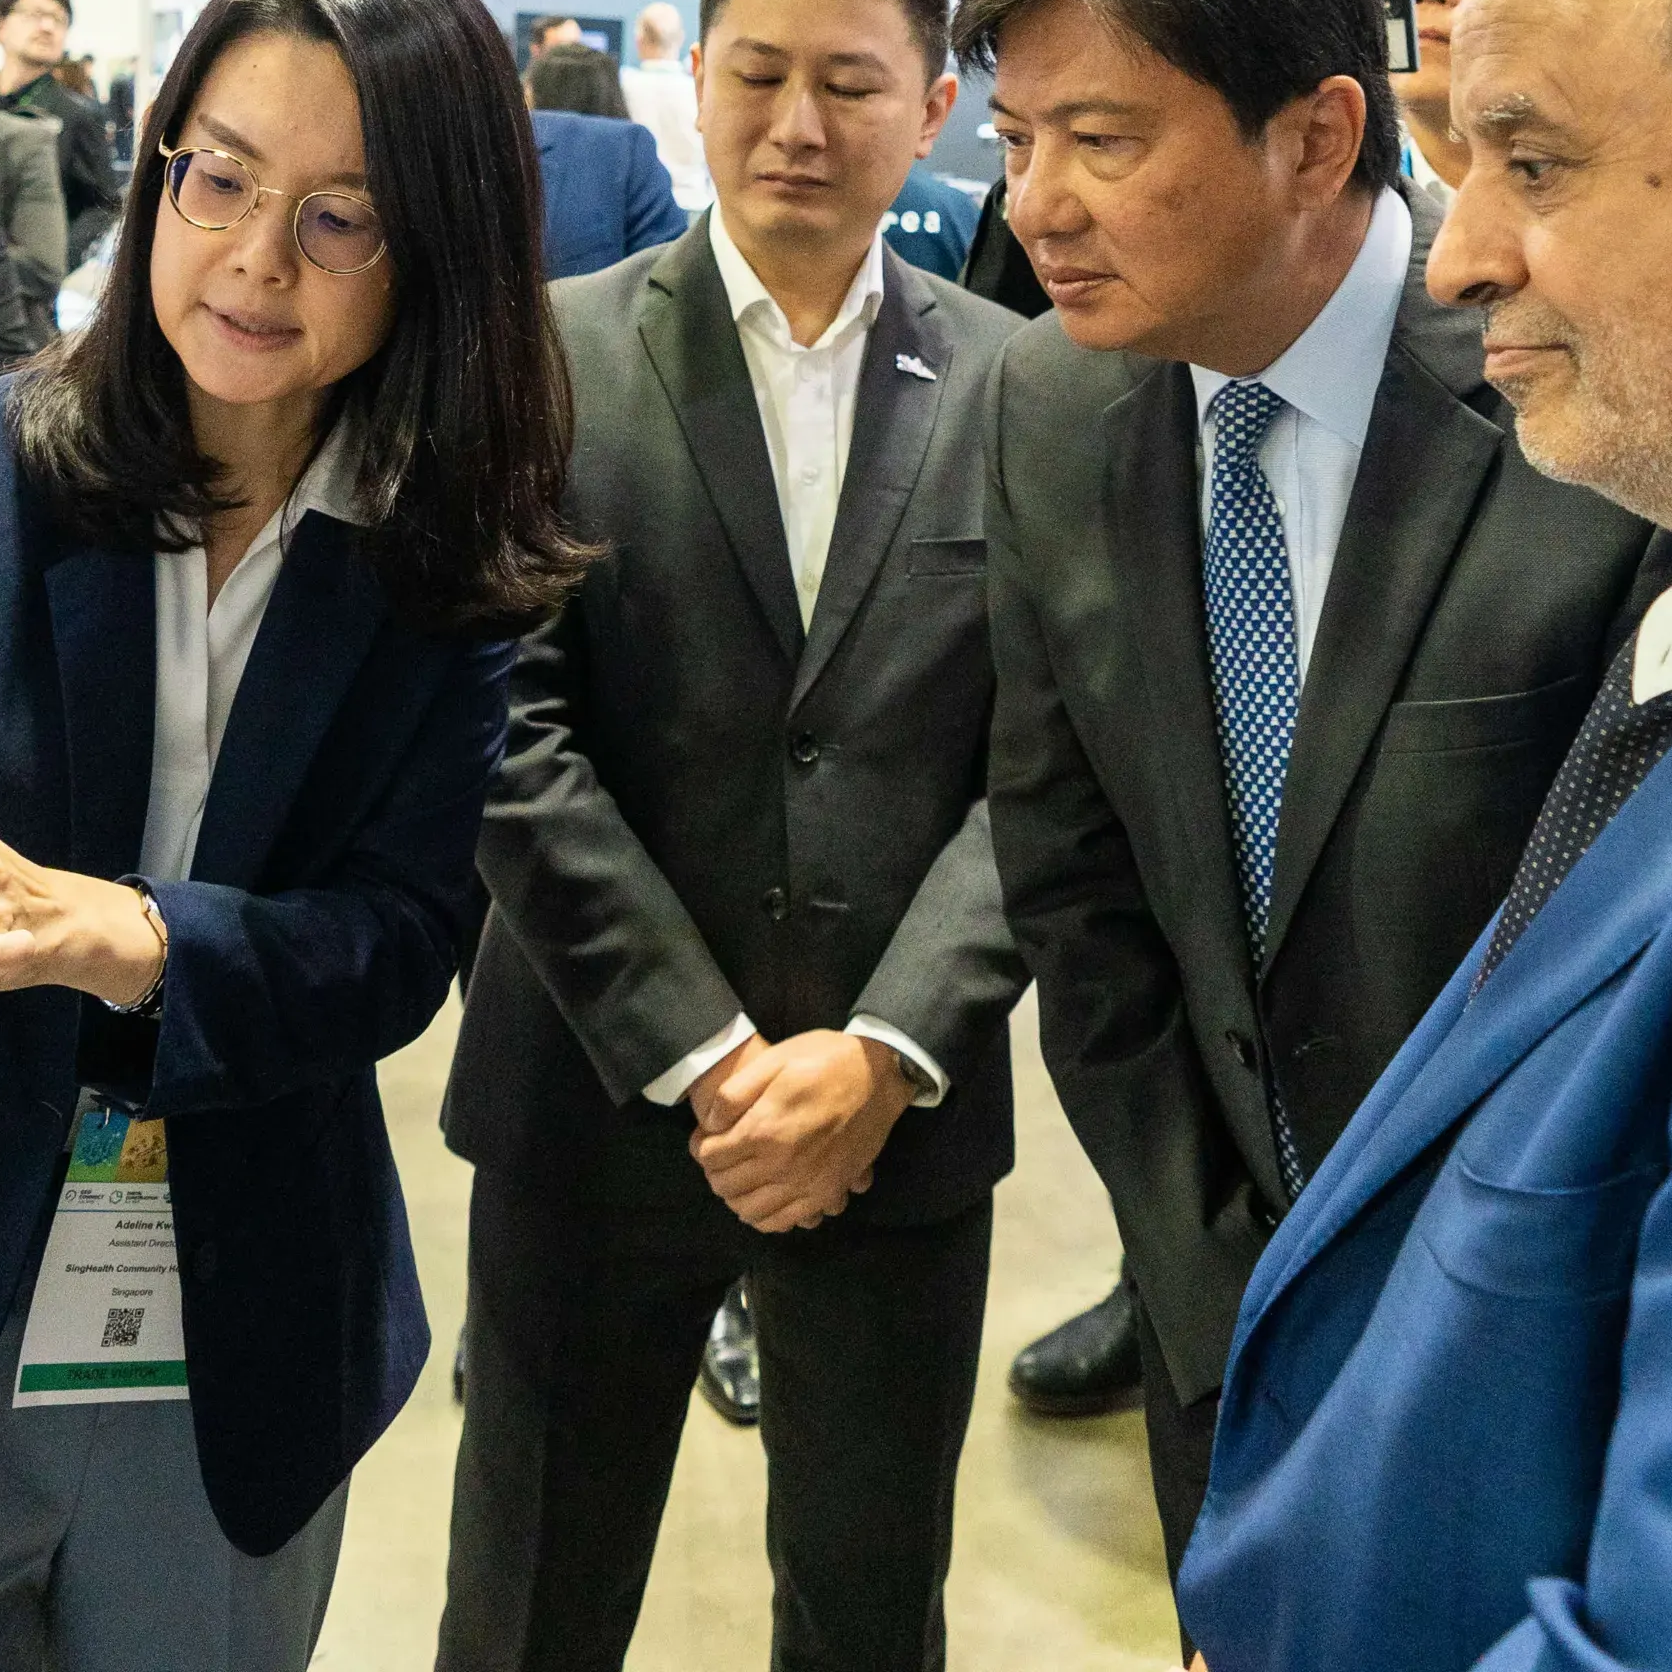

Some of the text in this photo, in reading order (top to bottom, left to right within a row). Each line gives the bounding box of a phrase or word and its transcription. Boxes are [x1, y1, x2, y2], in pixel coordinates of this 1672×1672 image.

[115, 1220, 153, 1230] Adeline
[108, 1238, 147, 1248] Assistant
[65, 1263, 115, 1275] SingHealth
[116, 1264, 167, 1275] Community
[111, 1288, 154, 1298] Singapore
